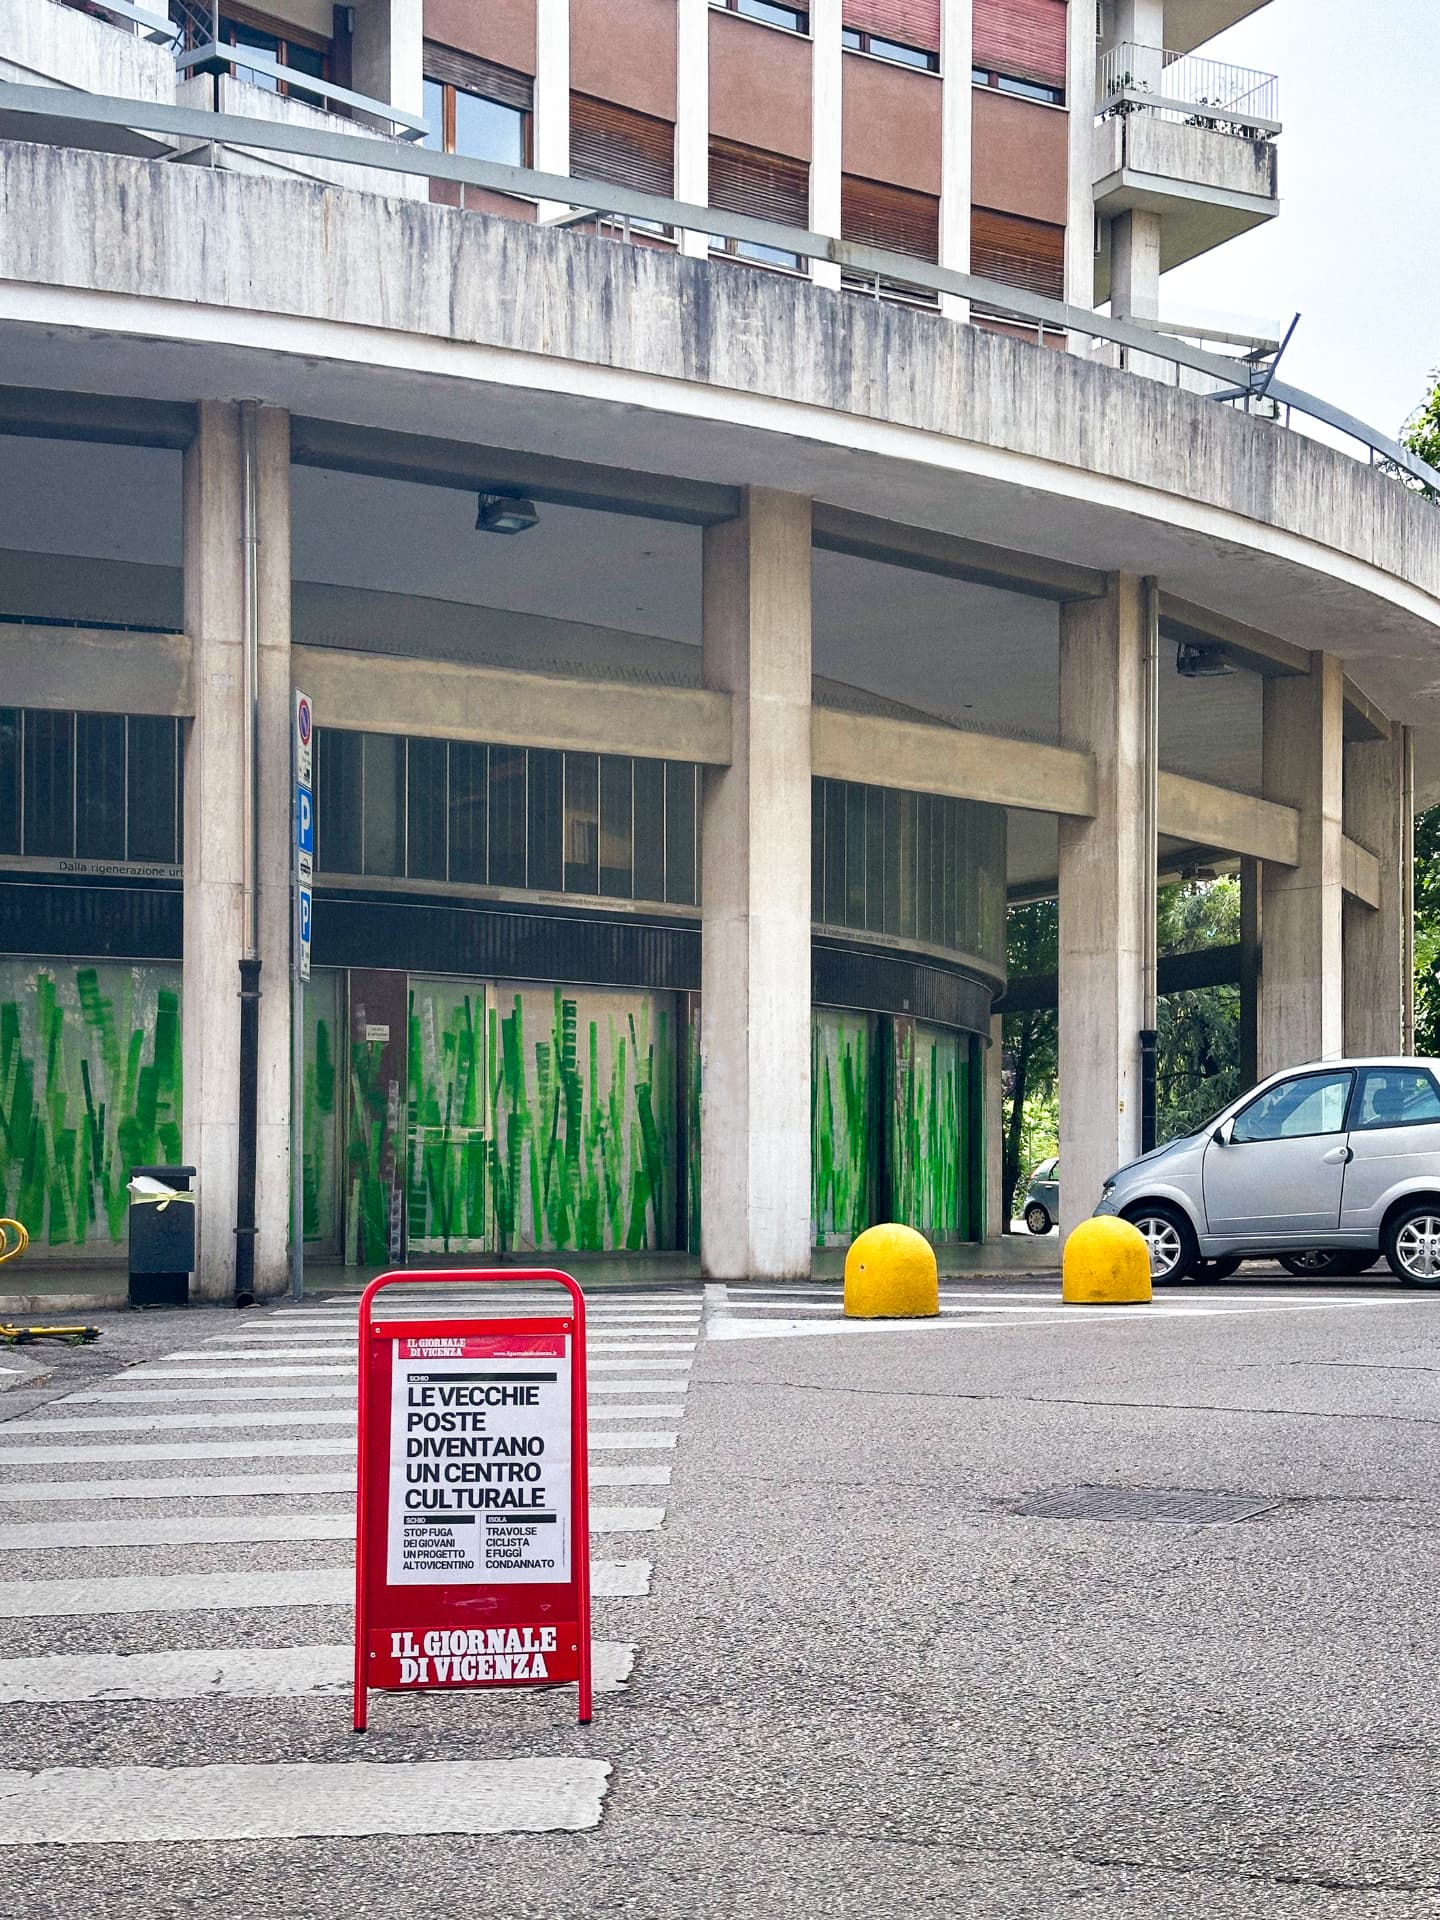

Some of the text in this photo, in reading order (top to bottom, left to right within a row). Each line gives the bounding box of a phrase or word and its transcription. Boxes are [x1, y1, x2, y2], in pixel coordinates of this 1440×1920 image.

[301, 794, 310, 844] P
[59, 861, 87, 873] Dalla
[91, 863, 165, 877] rigenerazione
[302, 899, 309, 935] P
[407, 1338, 466, 1348] IL GIORNALE
[410, 1347, 463, 1357] DI VICENZA
[408, 1386, 540, 1406] LE VECCHIE
[407, 1412, 486, 1432] POSTE
[407, 1437, 545, 1458] DIVENTANO
[406, 1462, 541, 1483] UN CENTRO
[405, 1488, 546, 1509] CULTURALE
[404, 1528, 453, 1537] STOP FUGA
[486, 1527, 537, 1536] TRAVOLSE
[404, 1539, 455, 1548] DEI GIOVANI
[486, 1538, 530, 1547] CICLISTA
[403, 1550, 465, 1559] UN PROGETTO
[486, 1548, 522, 1558] E FUGGÌ
[486, 1560, 554, 1569] CONDANNATO
[390, 1627, 557, 1657] IL GIORNALE
[400, 1654, 548, 1683] DI VICENZA
